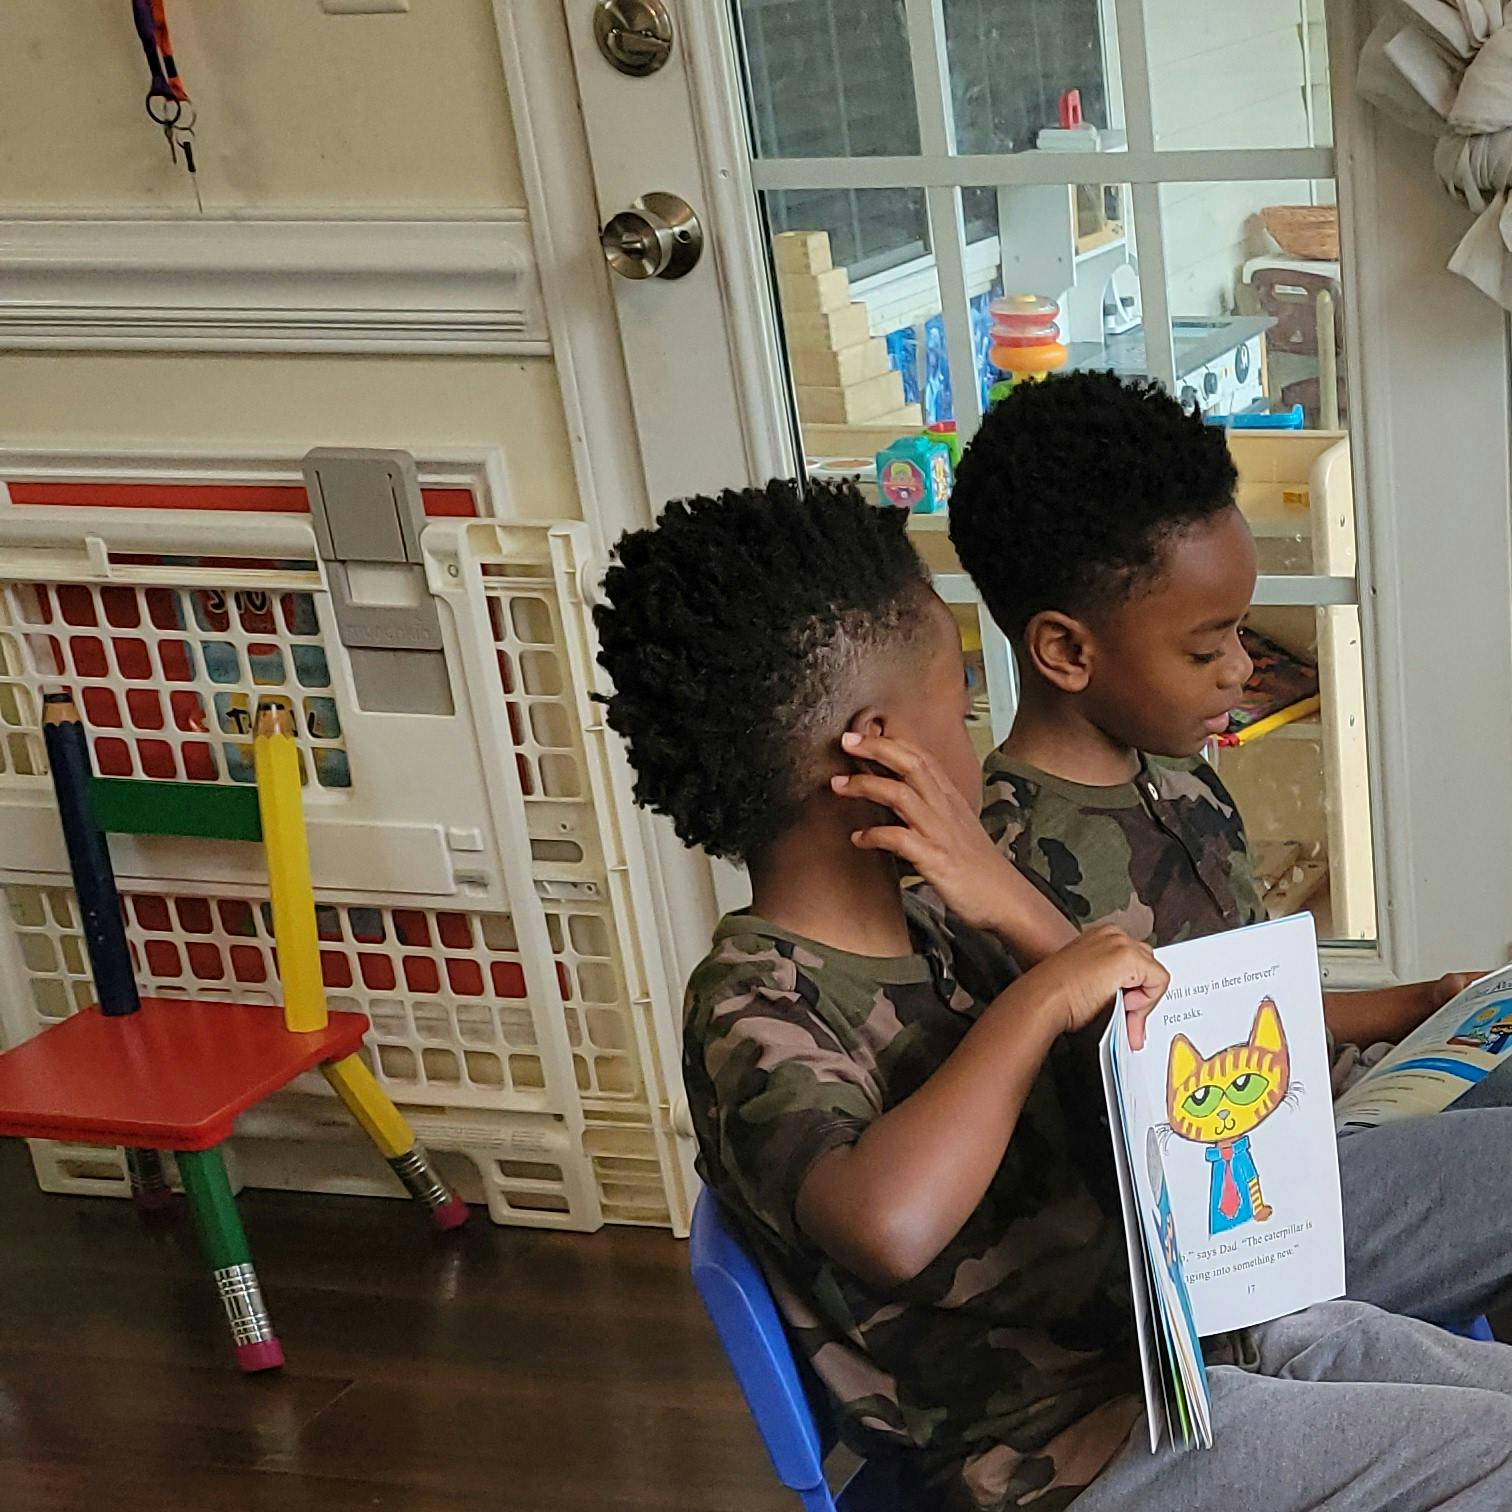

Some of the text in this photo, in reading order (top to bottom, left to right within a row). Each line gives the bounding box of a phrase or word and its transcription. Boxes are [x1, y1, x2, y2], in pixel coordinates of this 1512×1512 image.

[1165, 988, 1183, 1000] Will
[1184, 986, 1191, 997] it
[1193, 984, 1209, 996] stay
[1211, 980, 1220, 991] in
[1221, 977, 1242, 988] there
[1163, 1012, 1181, 1025] Pete
[1197, 1249, 1217, 1261] says
[1264, 1223, 1304, 1242] caterpillar
[1305, 1218, 1313, 1229] is
[1213, 1265, 1231, 1277] into
[1232, 1253, 1275, 1272] something
